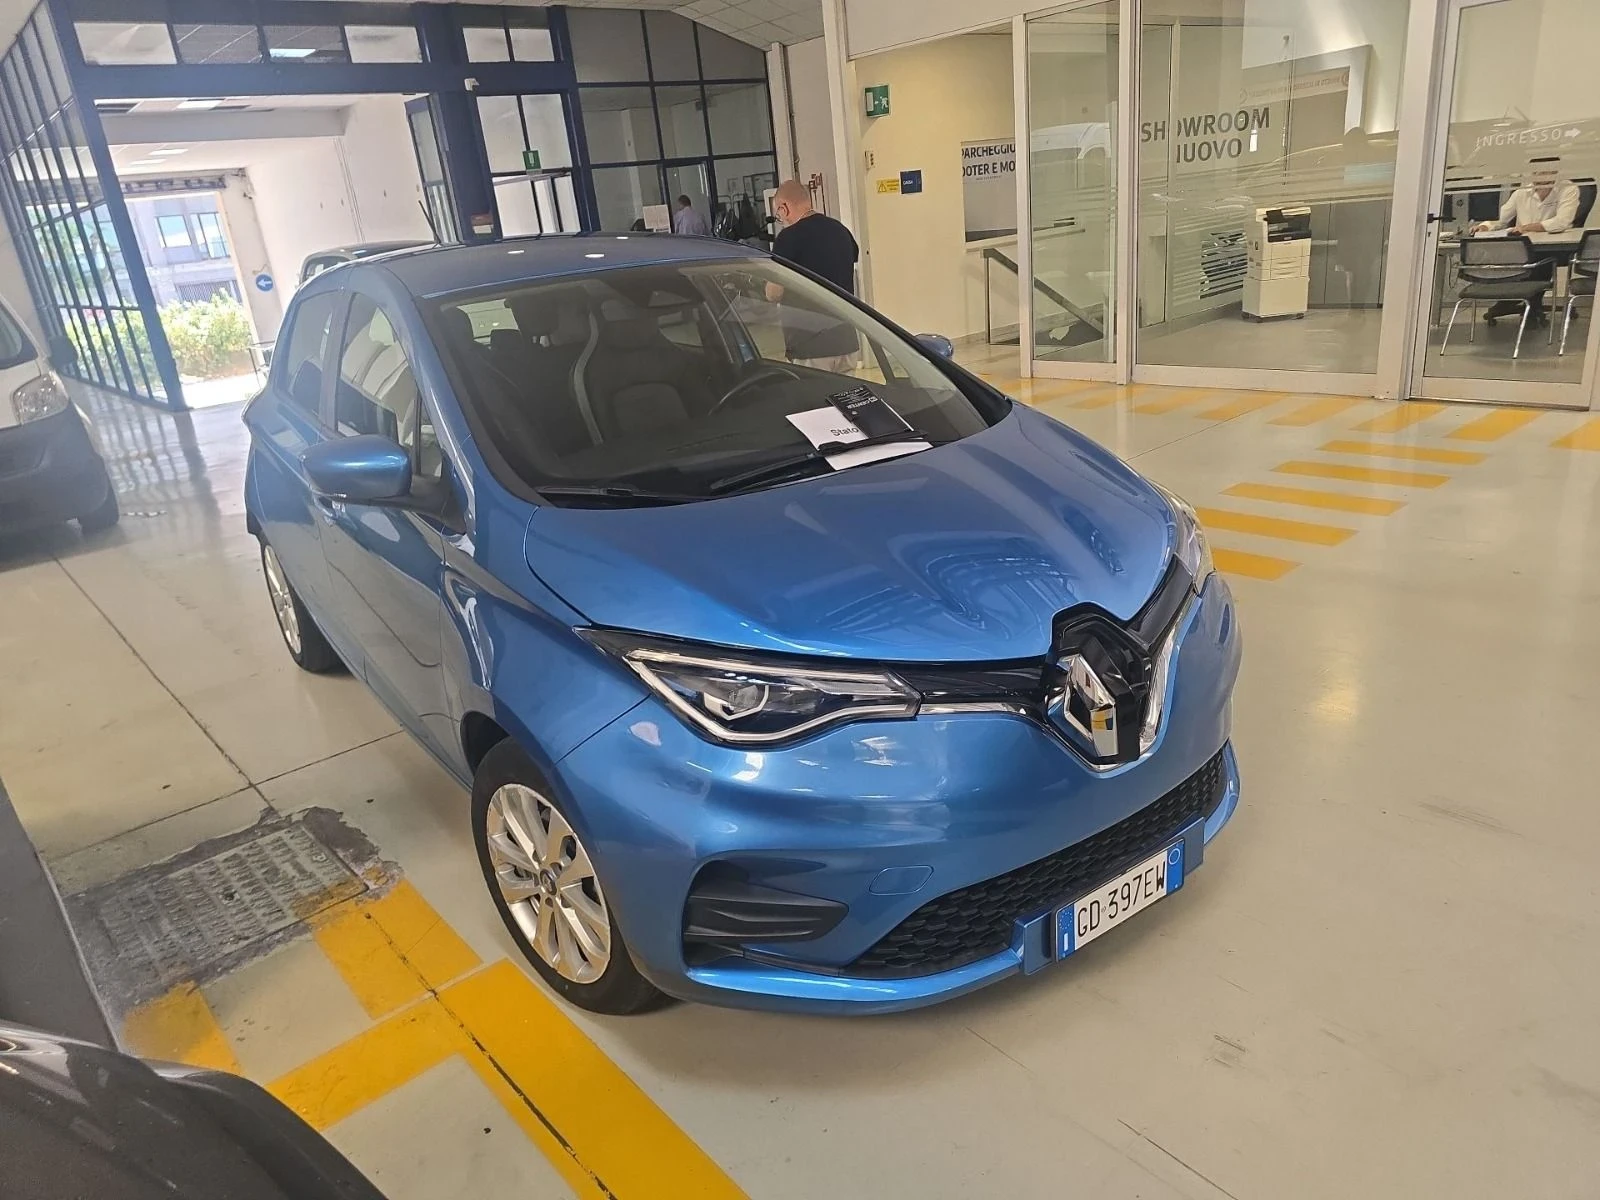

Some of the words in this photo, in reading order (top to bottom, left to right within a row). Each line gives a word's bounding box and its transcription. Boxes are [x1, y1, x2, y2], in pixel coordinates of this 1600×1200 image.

[1475, 128, 1561, 147] INGRESSO
[992, 162, 998, 174] E
[830, 426, 859, 437] Stato
[1076, 899, 1100, 937] GD
[1108, 861, 1166, 920] 397EW
